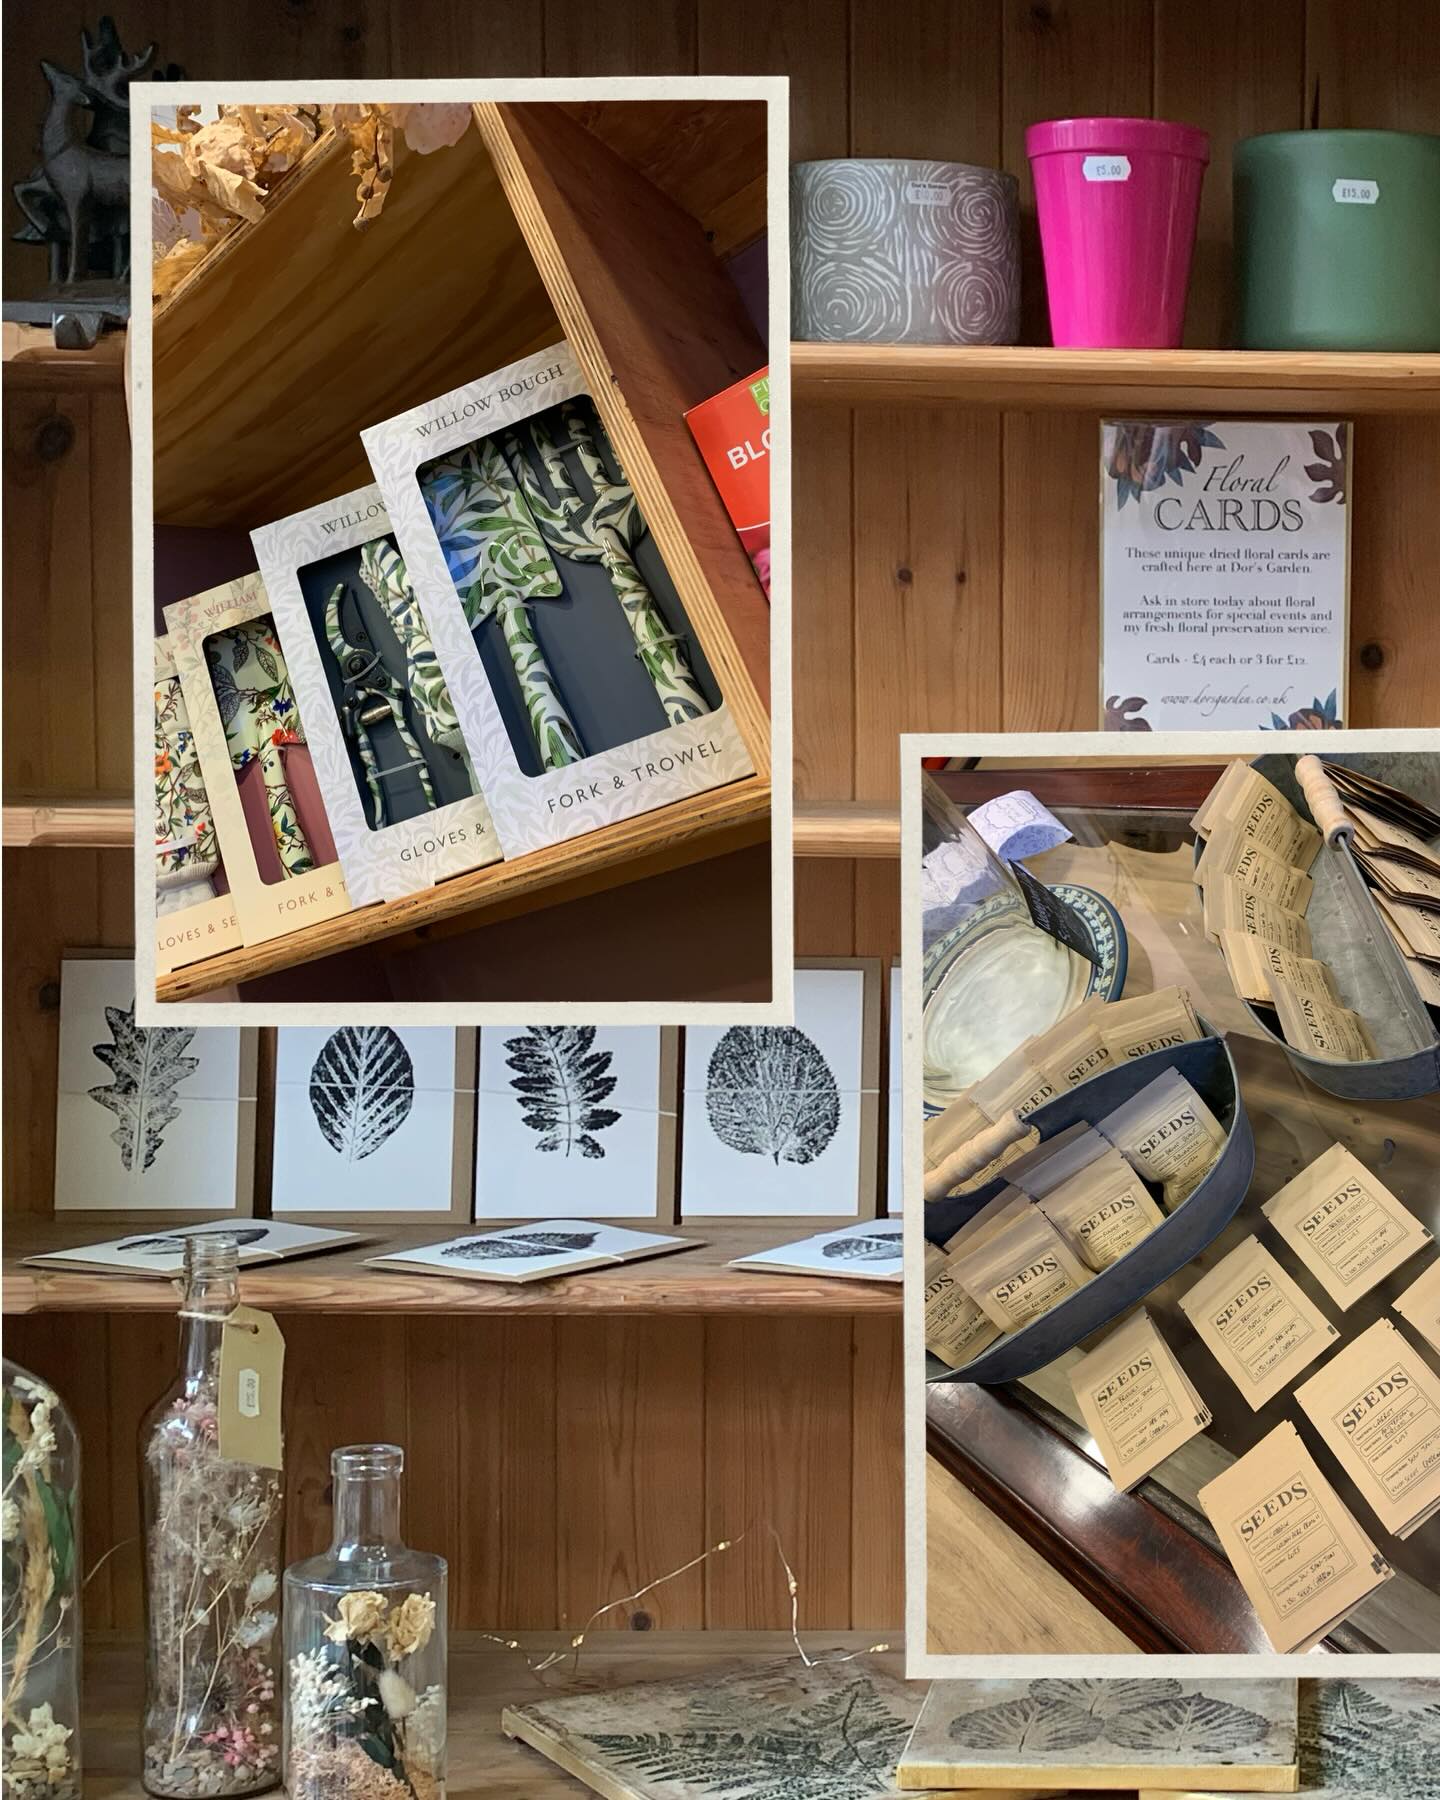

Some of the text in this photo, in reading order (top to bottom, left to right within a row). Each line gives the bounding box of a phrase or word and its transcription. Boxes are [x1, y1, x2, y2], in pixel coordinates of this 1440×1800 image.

[416, 363, 565, 438] WILLOW BOUGH
[1202, 454, 1291, 493] Floral
[1153, 497, 1304, 532] CARDS
[1125, 546, 1331, 563] These unique dried floral cards are
[1141, 561, 1183, 573] crafted
[1186, 561, 1213, 573] here
[1216, 562, 1226, 573] at
[1230, 562, 1263, 573] Dor's
[1122, 608, 1333, 623] arrangements for special events and
[1140, 595, 1316, 609] Ask in store today about floral
[1123, 624, 1141, 635] my
[1145, 622, 1174, 633] fresh
[1177, 622, 1208, 634] floral
[1211, 623, 1284, 636] preservation
[1146, 653, 1180, 664] Cards
[1192, 654, 1207, 666] £4
[1209, 654, 1236, 665] each
[1239, 656, 1253, 665] or
[1255, 654, 1263, 665] 3
[1266, 654, 1284, 665] for
[1160, 684, 1295, 717] www.dorsgarden.co.uk
[547, 740, 722, 813] FORK & TROWEL
[400, 823, 486, 862] GLOVES &
[277, 887, 334, 914] FORK &
[157, 923, 216, 951] LOVES &
[1127, 1033, 1185, 1058] SEEDS
[1067, 1046, 1109, 1085] SEED
[1139, 1110, 1196, 1160] SEEDS
[1080, 1194, 1136, 1239] SEEDS
[1303, 1183, 1362, 1237] SEEDS
[925, 1274, 954, 1304] EDS
[996, 1257, 1058, 1303] SEEDS
[1216, 1276, 1272, 1331] SEEDS
[1097, 1356, 1152, 1408] SEEDS
[1342, 1371, 1409, 1435] SEEDS
[1240, 1481, 1308, 1542] SEEDS
